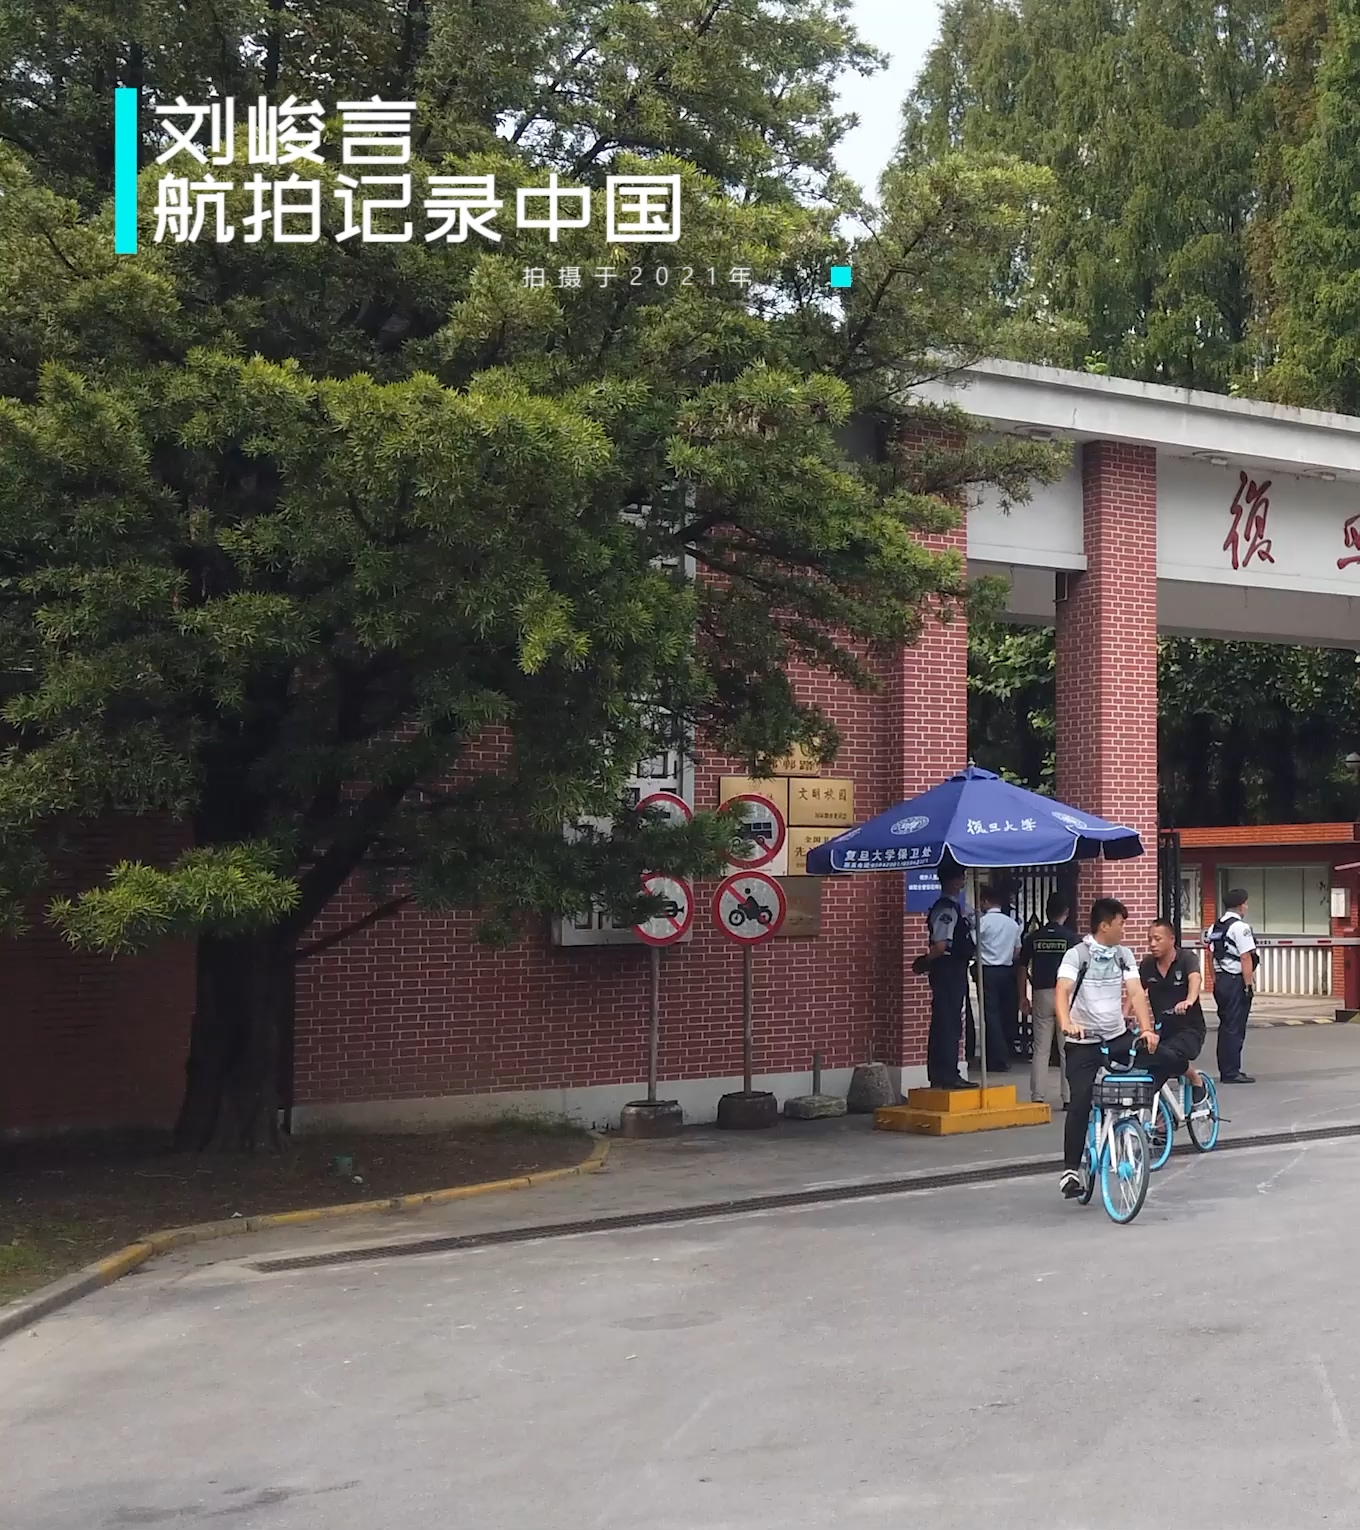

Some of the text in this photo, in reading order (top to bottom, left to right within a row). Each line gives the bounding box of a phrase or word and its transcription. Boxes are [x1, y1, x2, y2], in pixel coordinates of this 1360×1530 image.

[844, 846, 932, 862] 复旦大学保卫处
